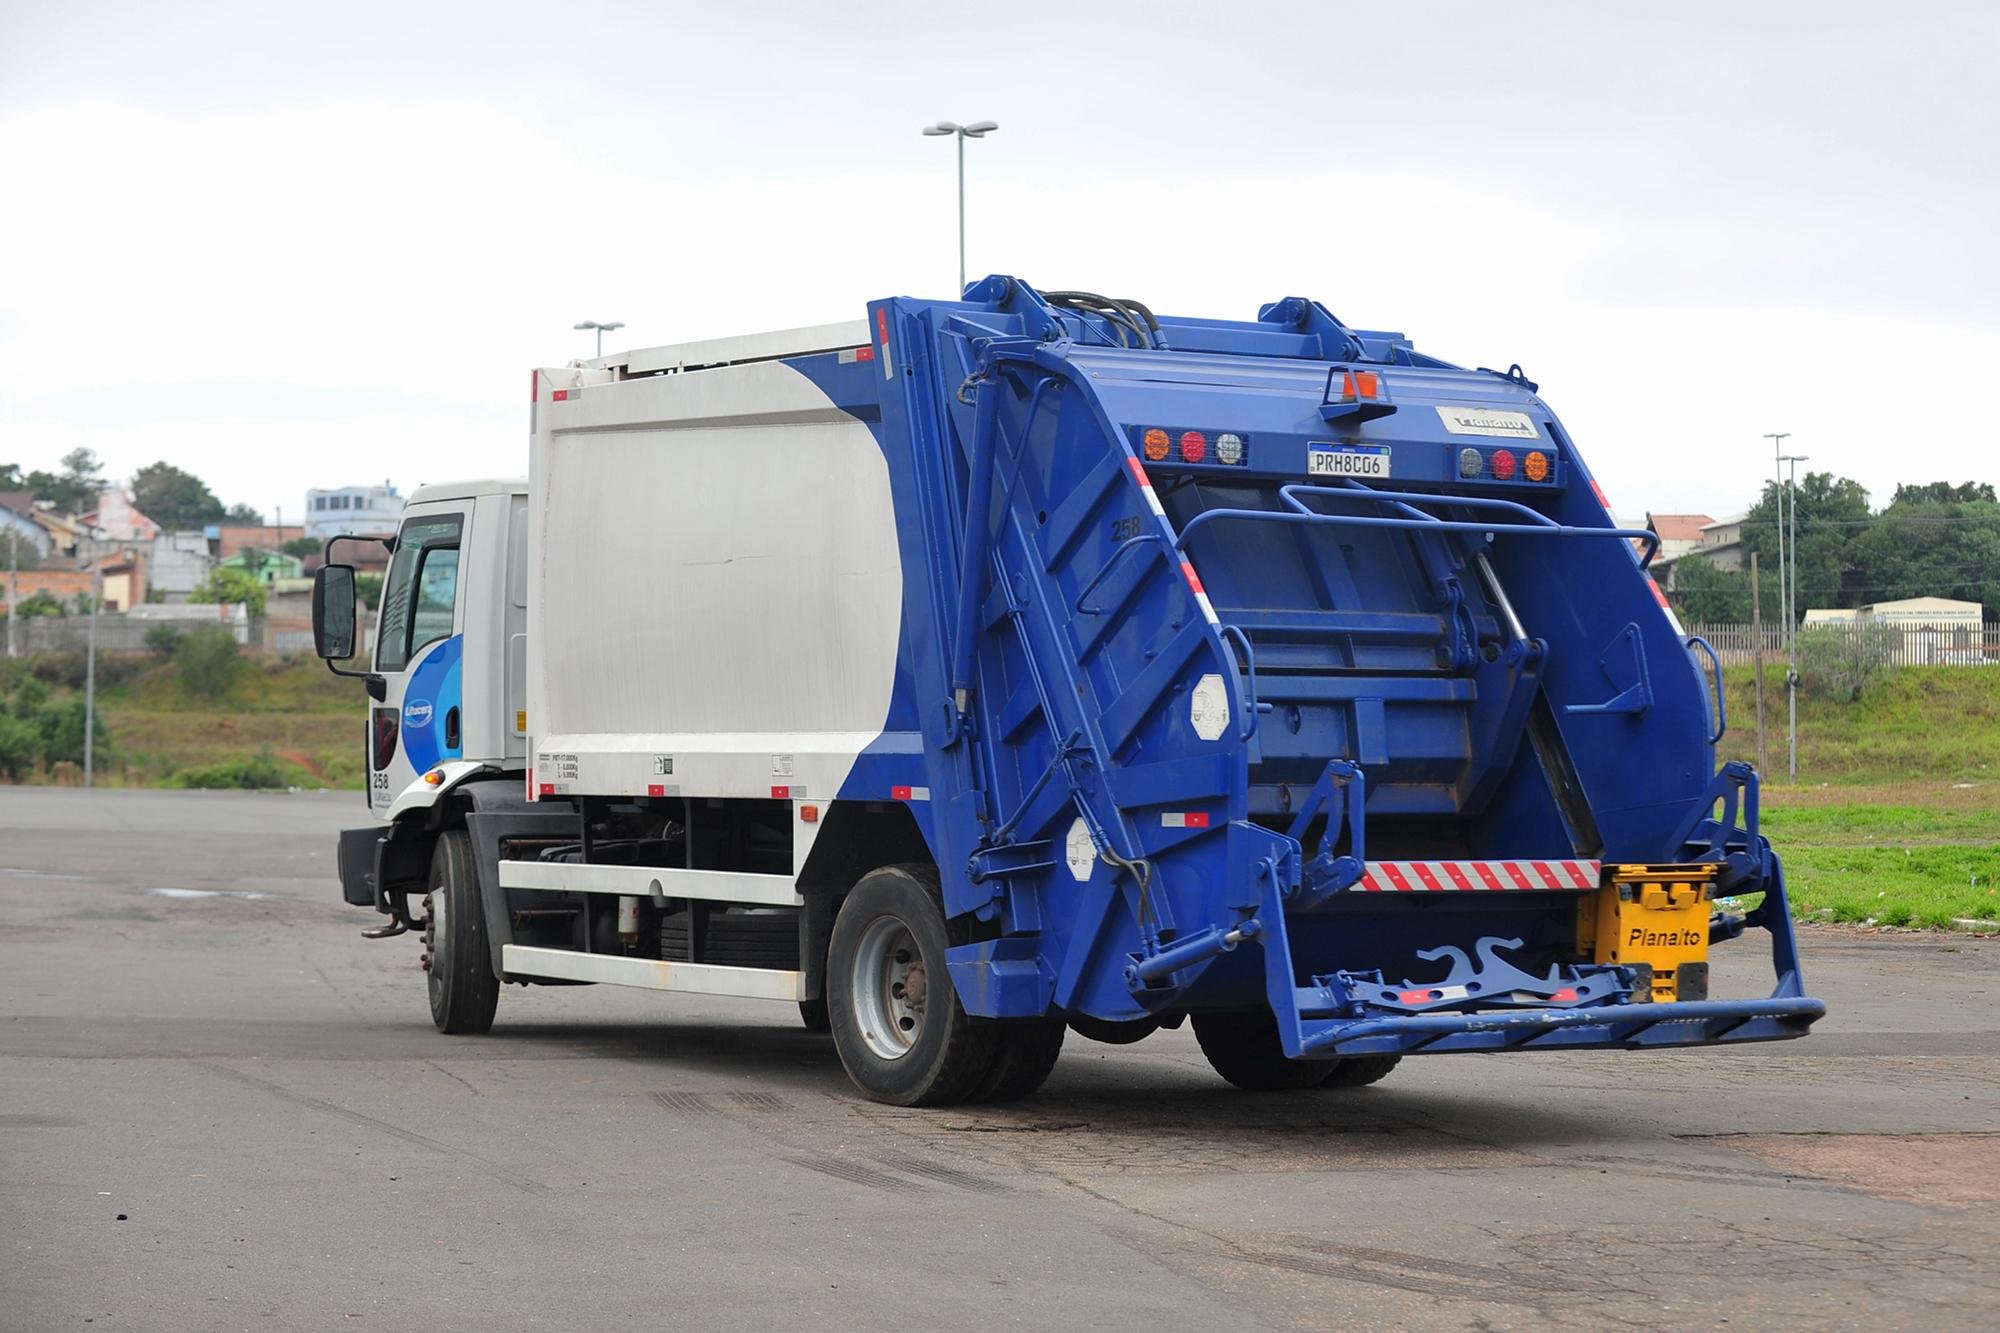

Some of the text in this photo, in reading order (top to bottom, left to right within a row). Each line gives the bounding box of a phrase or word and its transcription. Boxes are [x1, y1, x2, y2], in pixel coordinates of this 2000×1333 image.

[1111, 514, 1141, 543] 258
[373, 773, 389, 790] 258
[1628, 927, 1701, 947] Planalto
